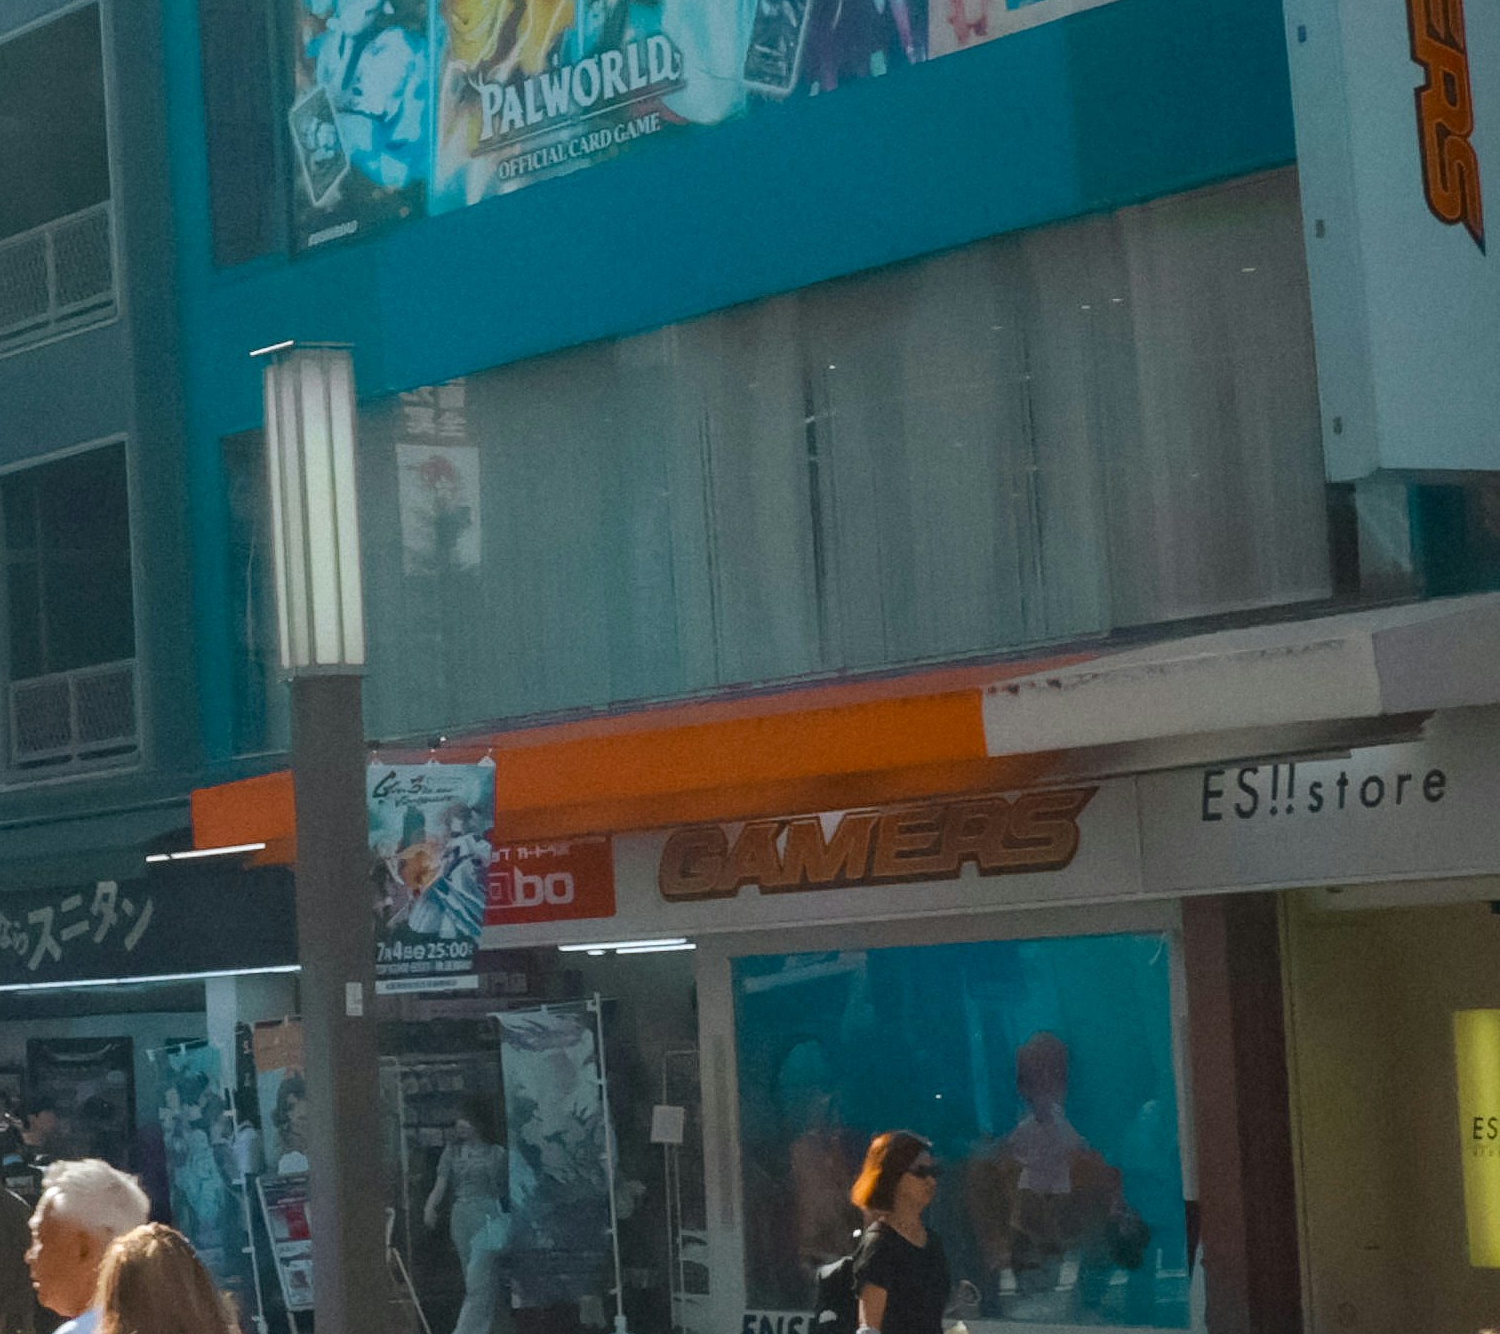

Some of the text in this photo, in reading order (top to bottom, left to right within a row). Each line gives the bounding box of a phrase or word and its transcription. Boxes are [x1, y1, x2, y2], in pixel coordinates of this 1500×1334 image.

[479, 34, 681, 141] PALWORLD
[499, 112, 661, 179] OFFICIAL CARD GAME
[656, 785, 1098, 903] GAMERS
